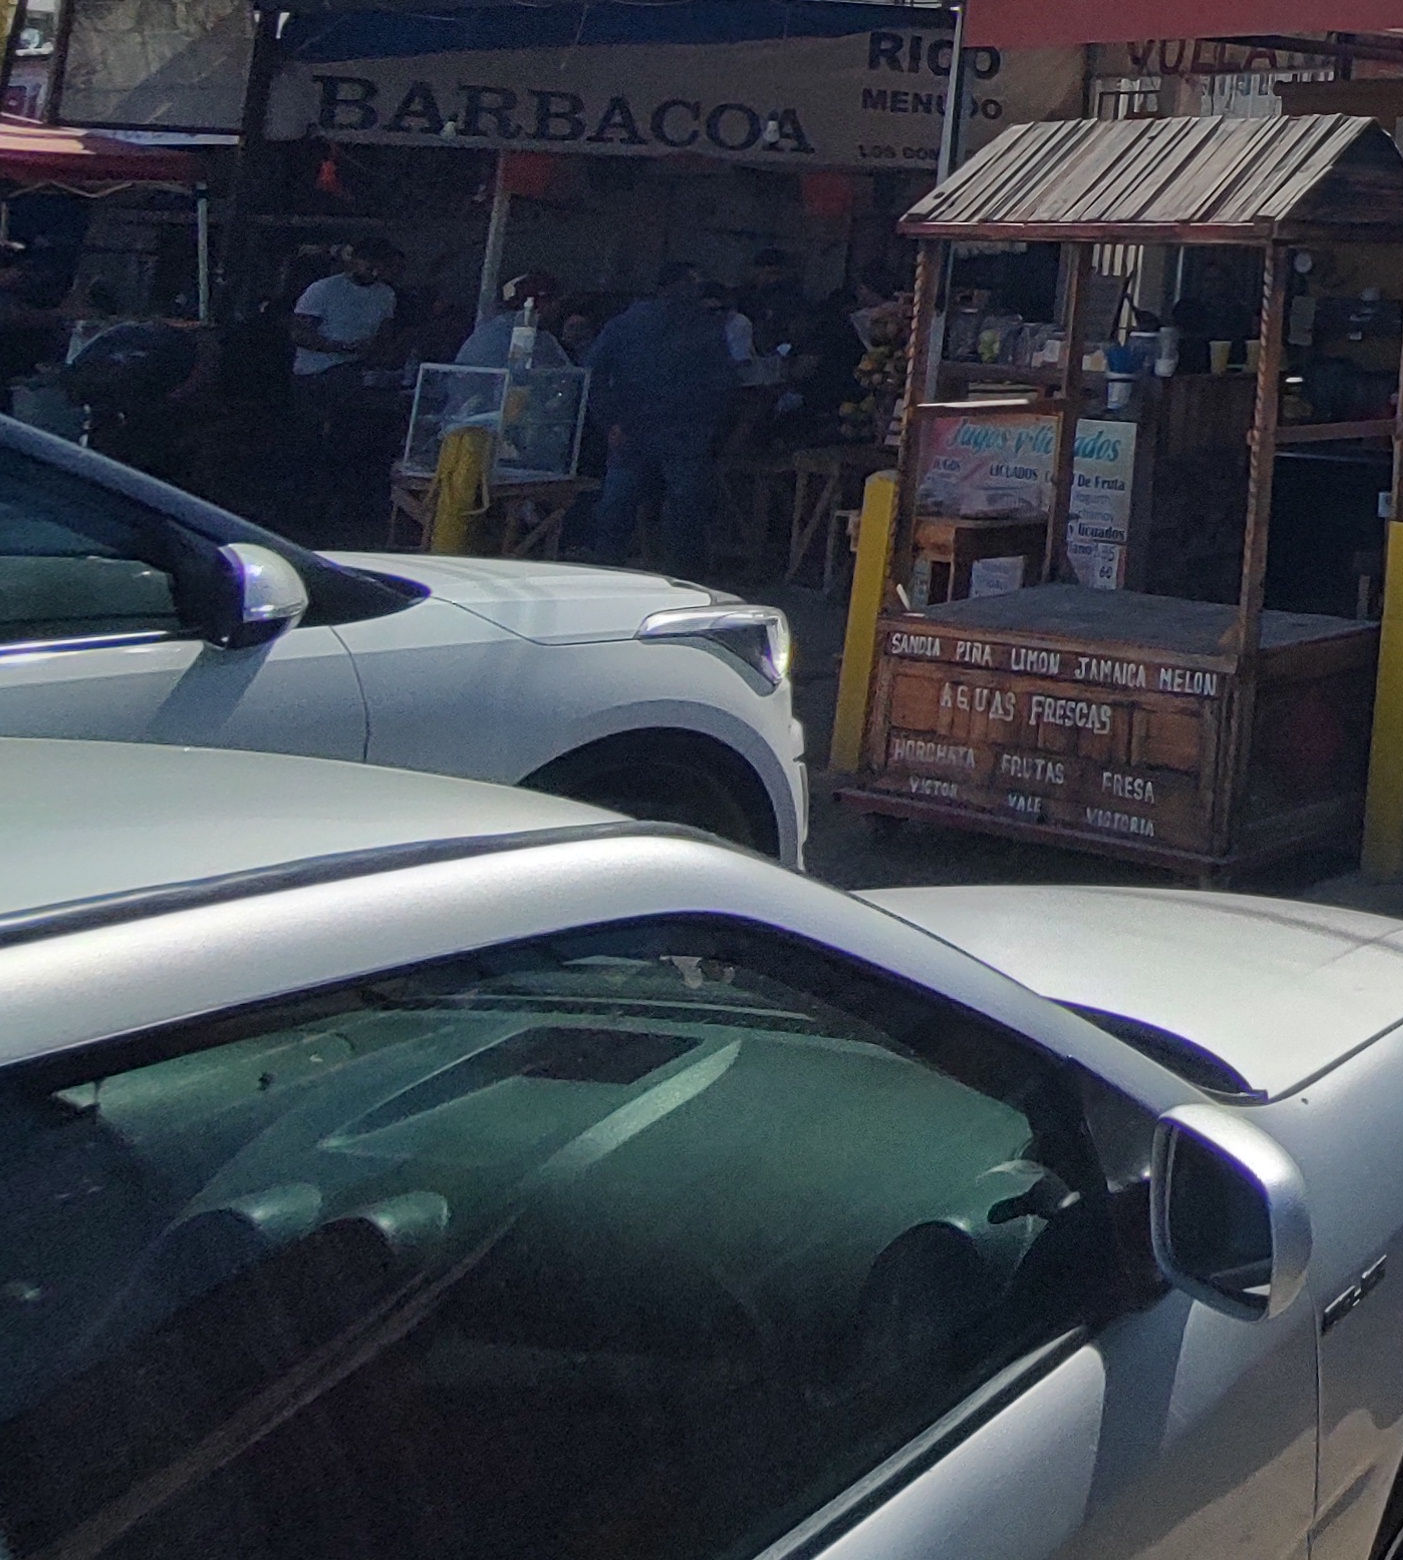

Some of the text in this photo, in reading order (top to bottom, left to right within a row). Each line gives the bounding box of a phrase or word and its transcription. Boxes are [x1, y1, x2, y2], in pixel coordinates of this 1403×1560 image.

[868, 32, 1001, 80] RICO
[312, 75, 815, 153] BARBACOA
[1094, 476, 1125, 490] Fruta
[891, 632, 941, 657] SANDIA
[1010, 647, 1061, 676] LIMON
[1074, 656, 1147, 689] JAMAICA
[1159, 667, 1218, 696] MELON
[940, 681, 1113, 735] AGUAS FRESCAS
[892, 737, 1155, 804] HORCHATA FRUTAS FRESA
[1007, 792, 1043, 813] VALE
